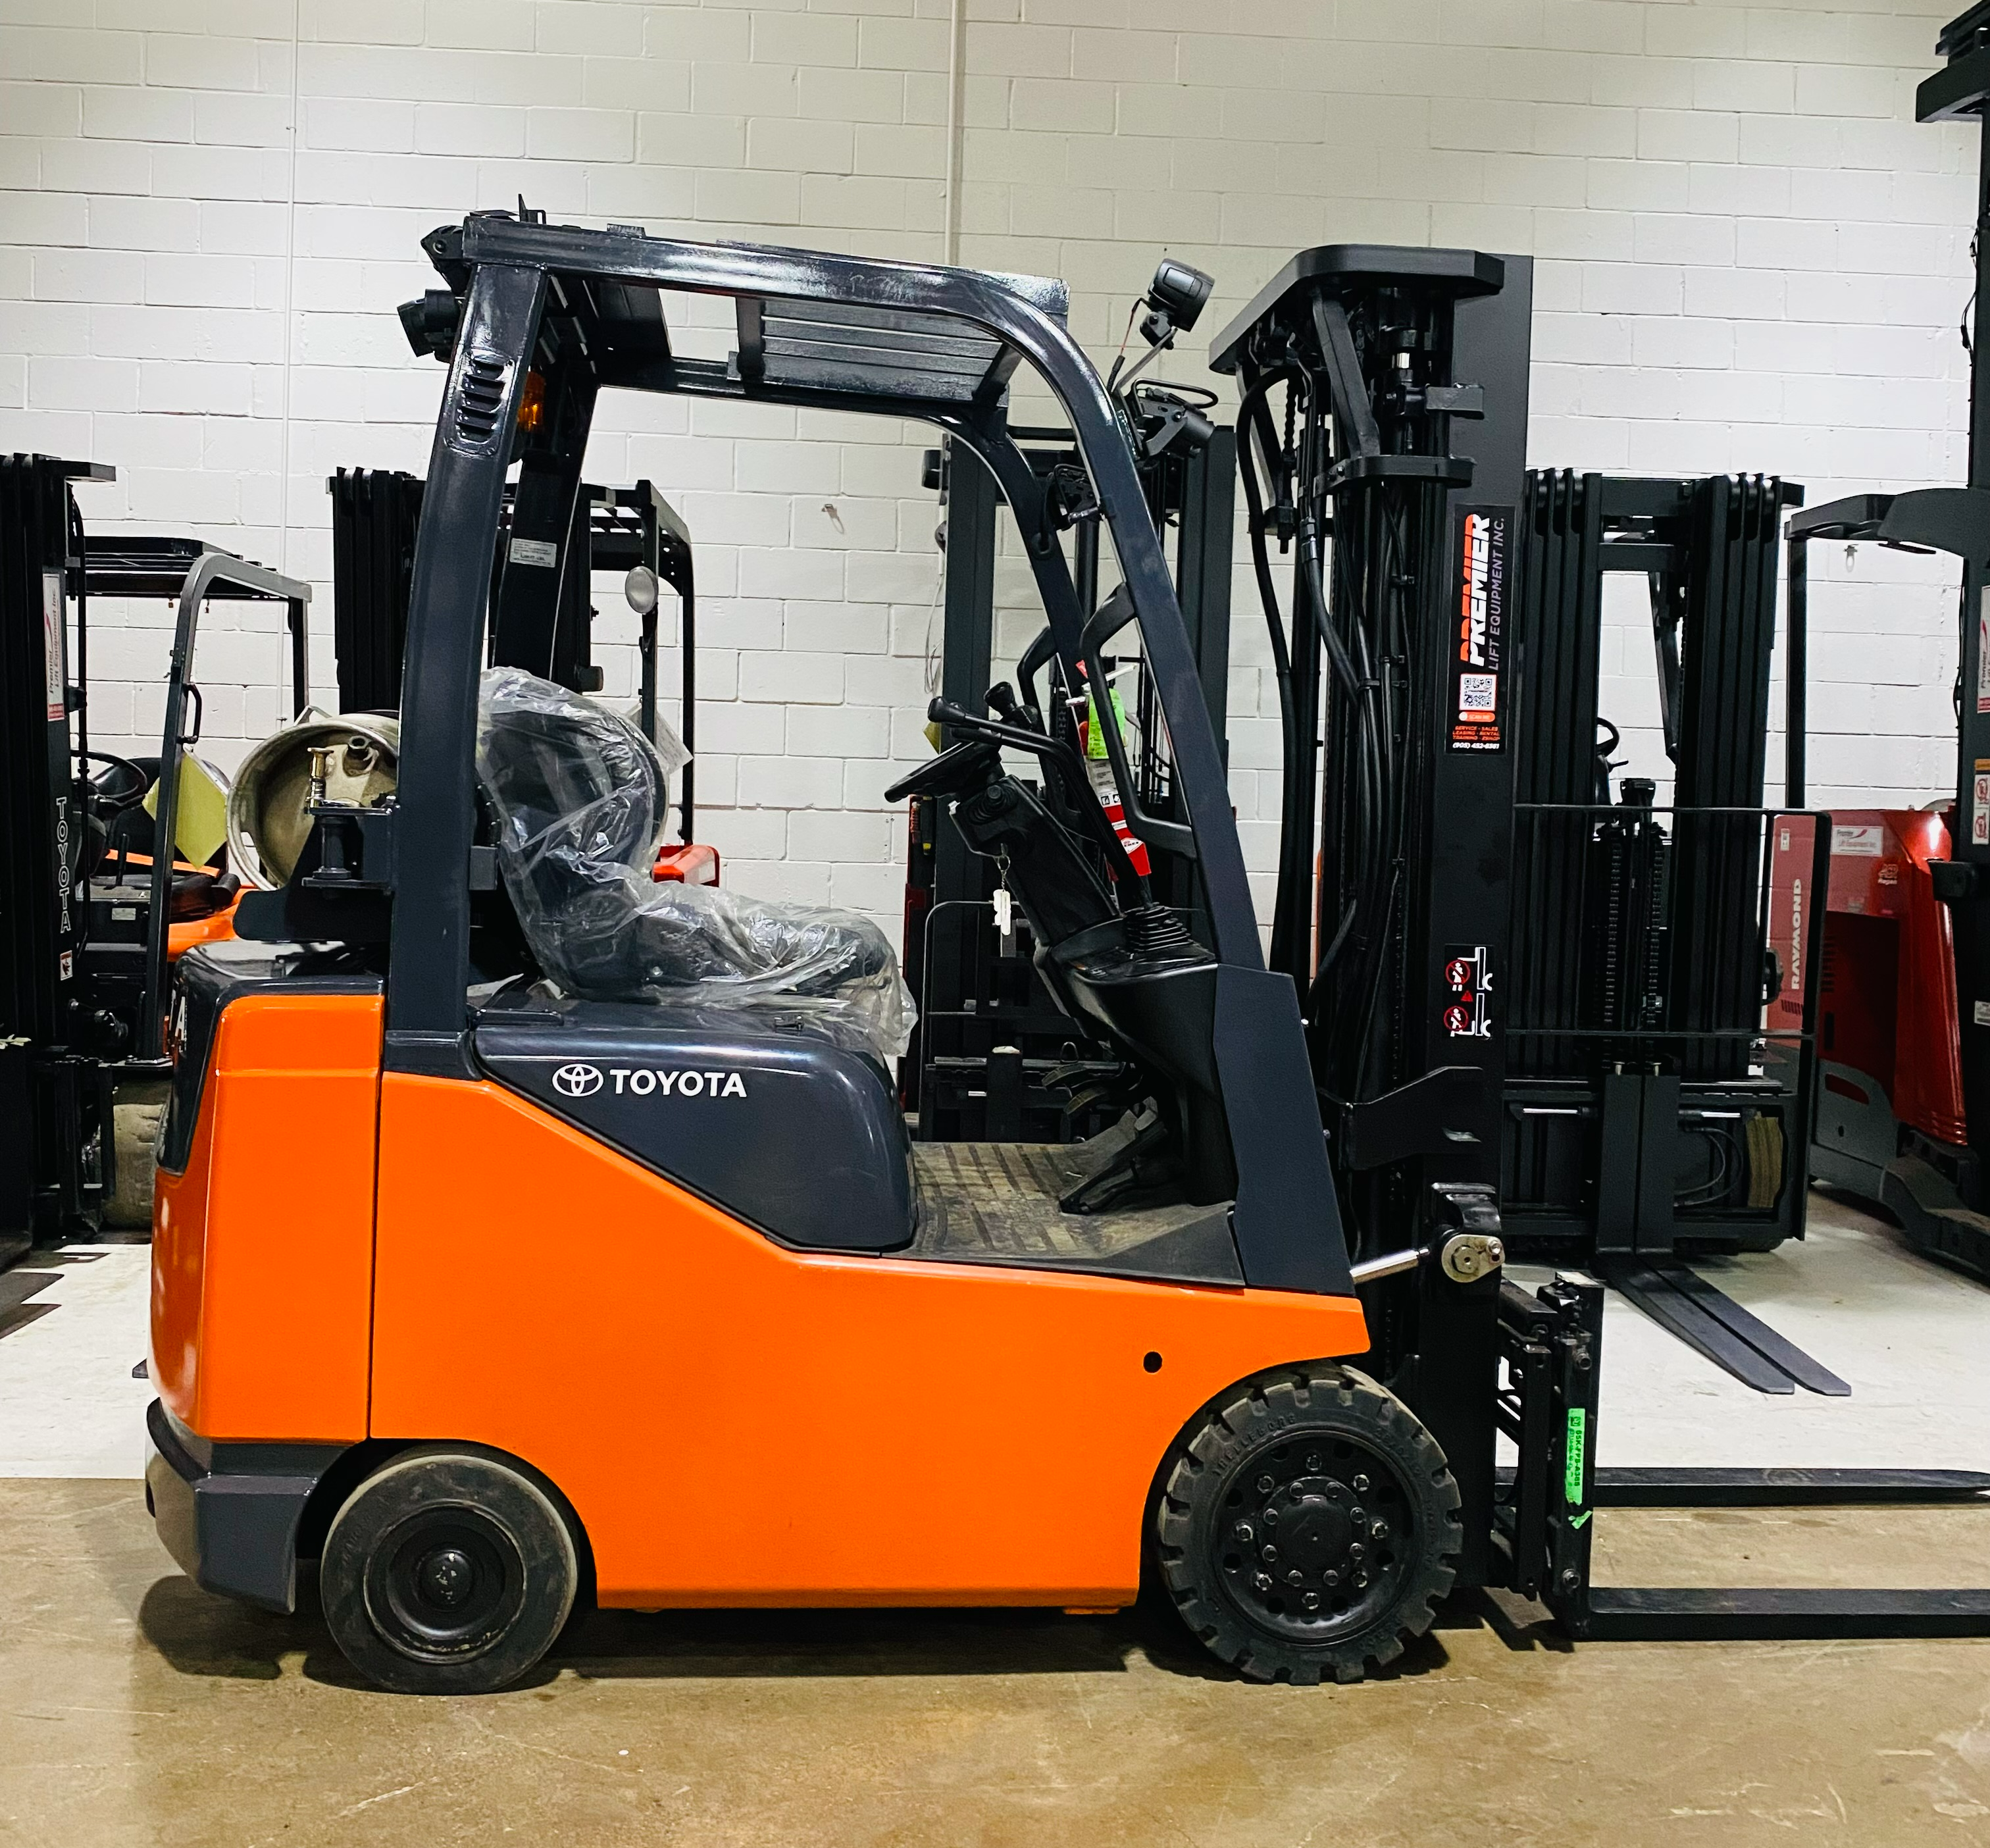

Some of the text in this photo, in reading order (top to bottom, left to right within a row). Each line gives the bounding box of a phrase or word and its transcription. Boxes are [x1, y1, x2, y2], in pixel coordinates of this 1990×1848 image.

[1460, 514, 1490, 666] PREMIER
[1488, 518, 1505, 671] LIFT EQUIPMENT INC.
[56, 796, 71, 934] TOYOTA
[1791, 879, 1802, 989] RAYMOND
[609, 1069, 748, 1098] TOYOTA
